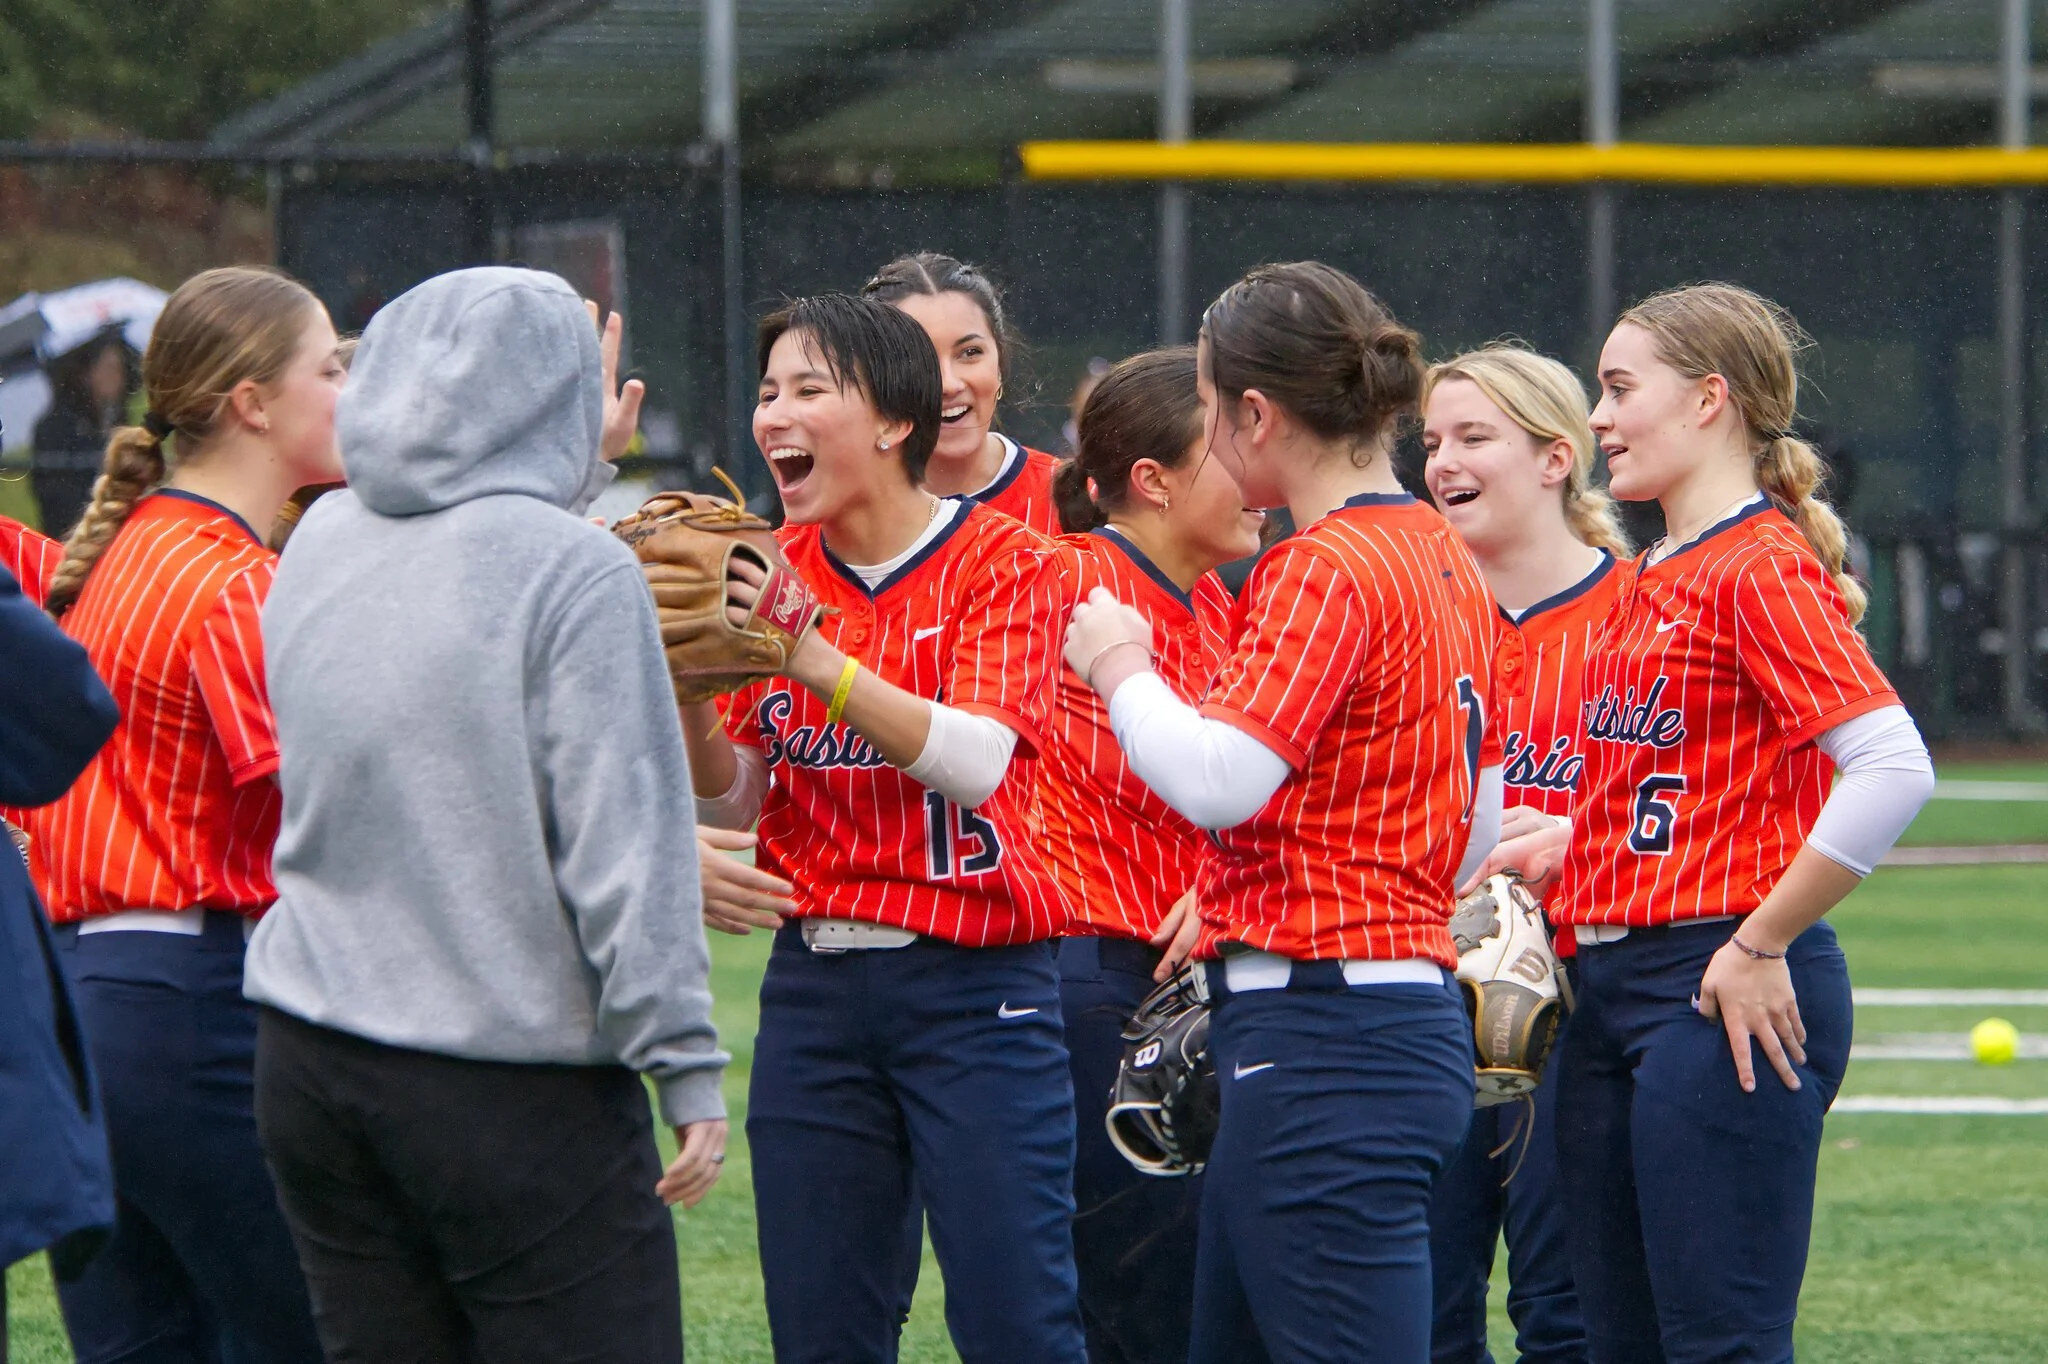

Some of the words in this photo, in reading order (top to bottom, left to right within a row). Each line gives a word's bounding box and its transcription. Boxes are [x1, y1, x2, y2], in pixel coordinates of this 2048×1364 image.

[1584, 675, 1688, 749] tside
[923, 788, 1003, 881] 15
[1627, 773, 1688, 856] 6
